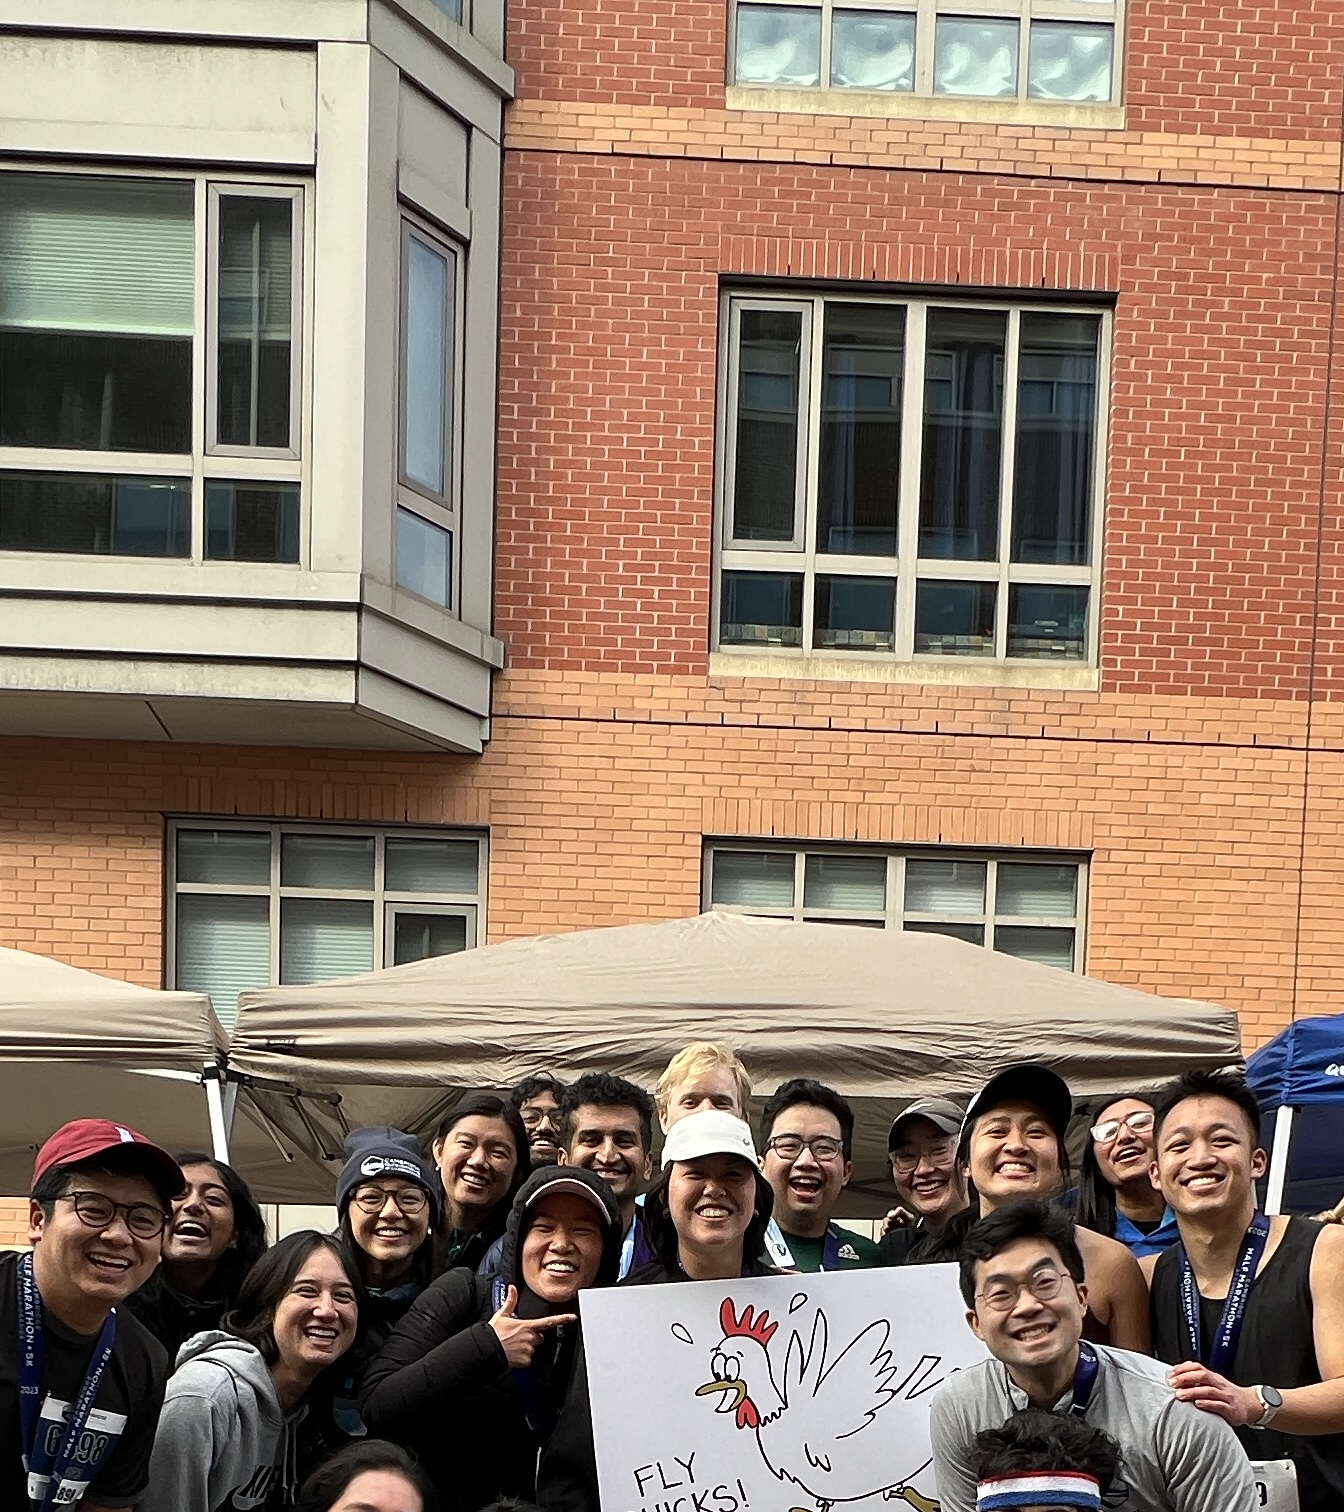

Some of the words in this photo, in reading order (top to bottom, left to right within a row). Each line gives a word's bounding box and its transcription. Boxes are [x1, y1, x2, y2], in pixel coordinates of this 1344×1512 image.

[23, 1277, 34, 1343] MARATHON
[1225, 1274, 1247, 1329] MARATHON
[44, 1423, 110, 1466] 698
[633, 1451, 696, 1498] FLY
